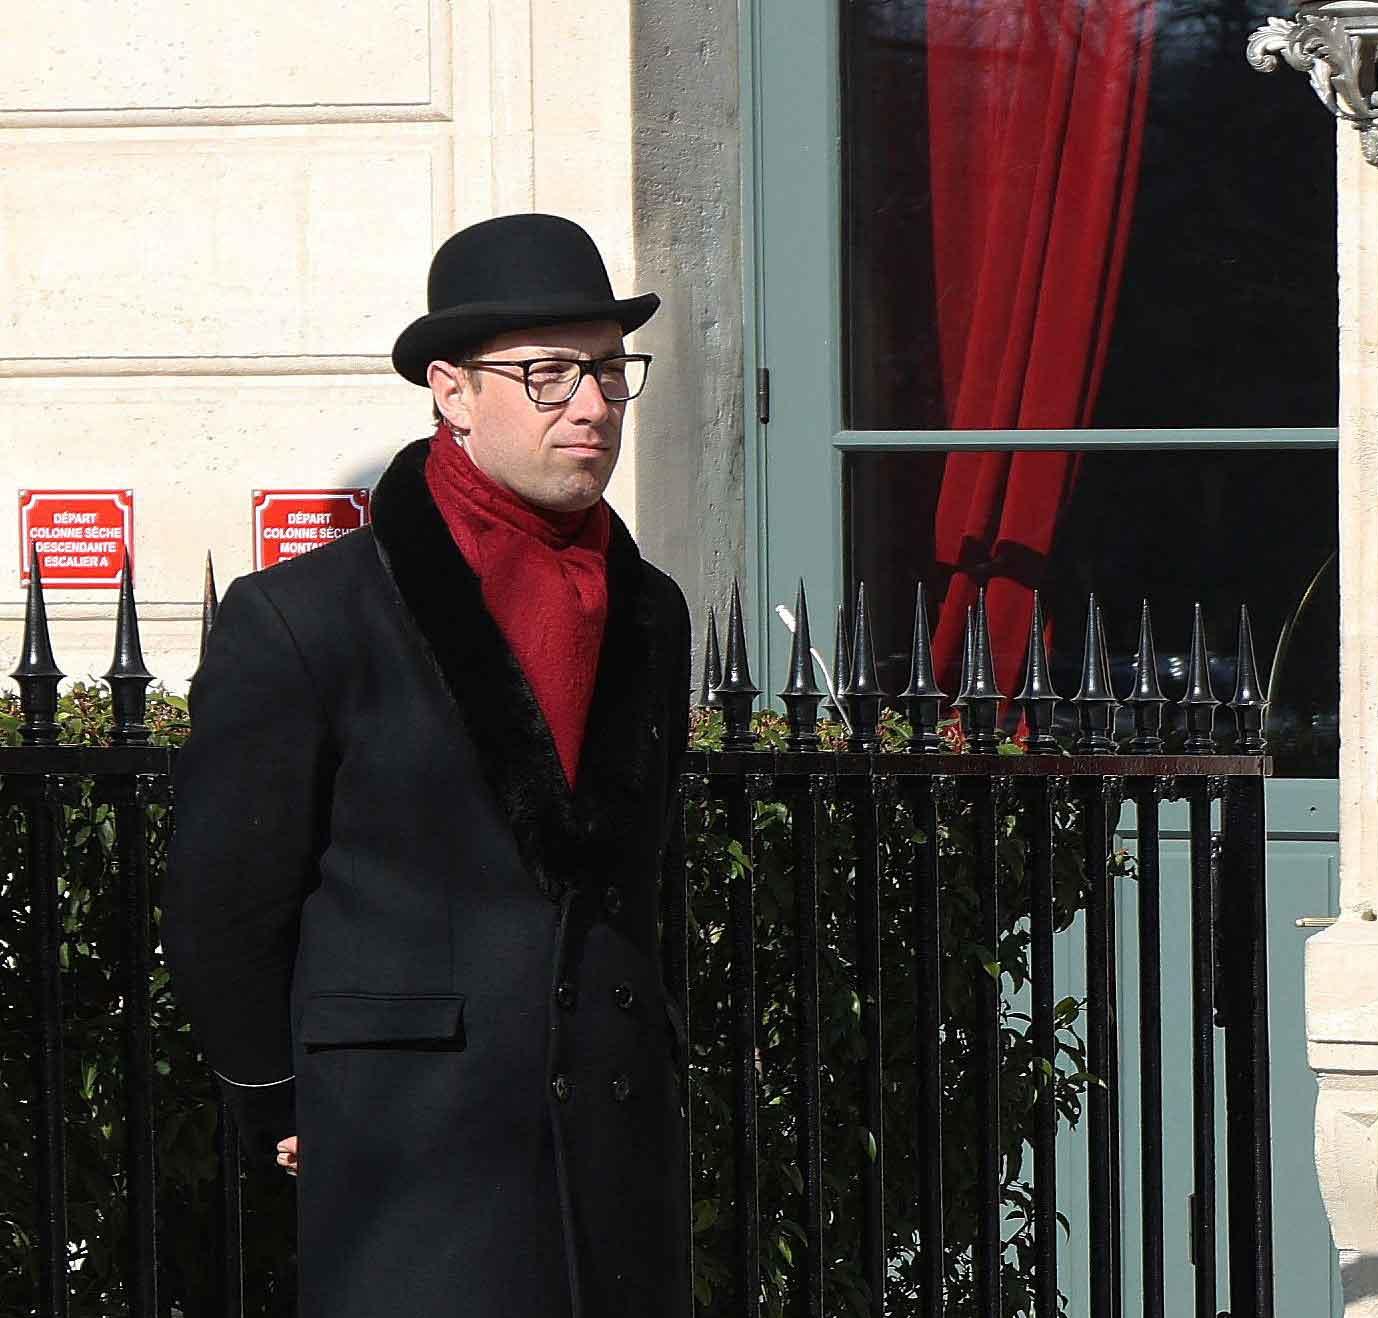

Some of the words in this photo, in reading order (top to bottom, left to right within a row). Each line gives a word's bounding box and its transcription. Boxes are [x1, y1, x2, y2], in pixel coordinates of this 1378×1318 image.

[53, 512, 97, 524] DÉPART
[288, 512, 331, 524] DÉPART
[30, 528, 82, 538] COLONNE
[264, 528, 317, 538] COLONNE
[35, 542, 116, 552] DESCENDANTE
[44, 556, 98, 567] ESCALIER
[98, 556, 108, 567] A
